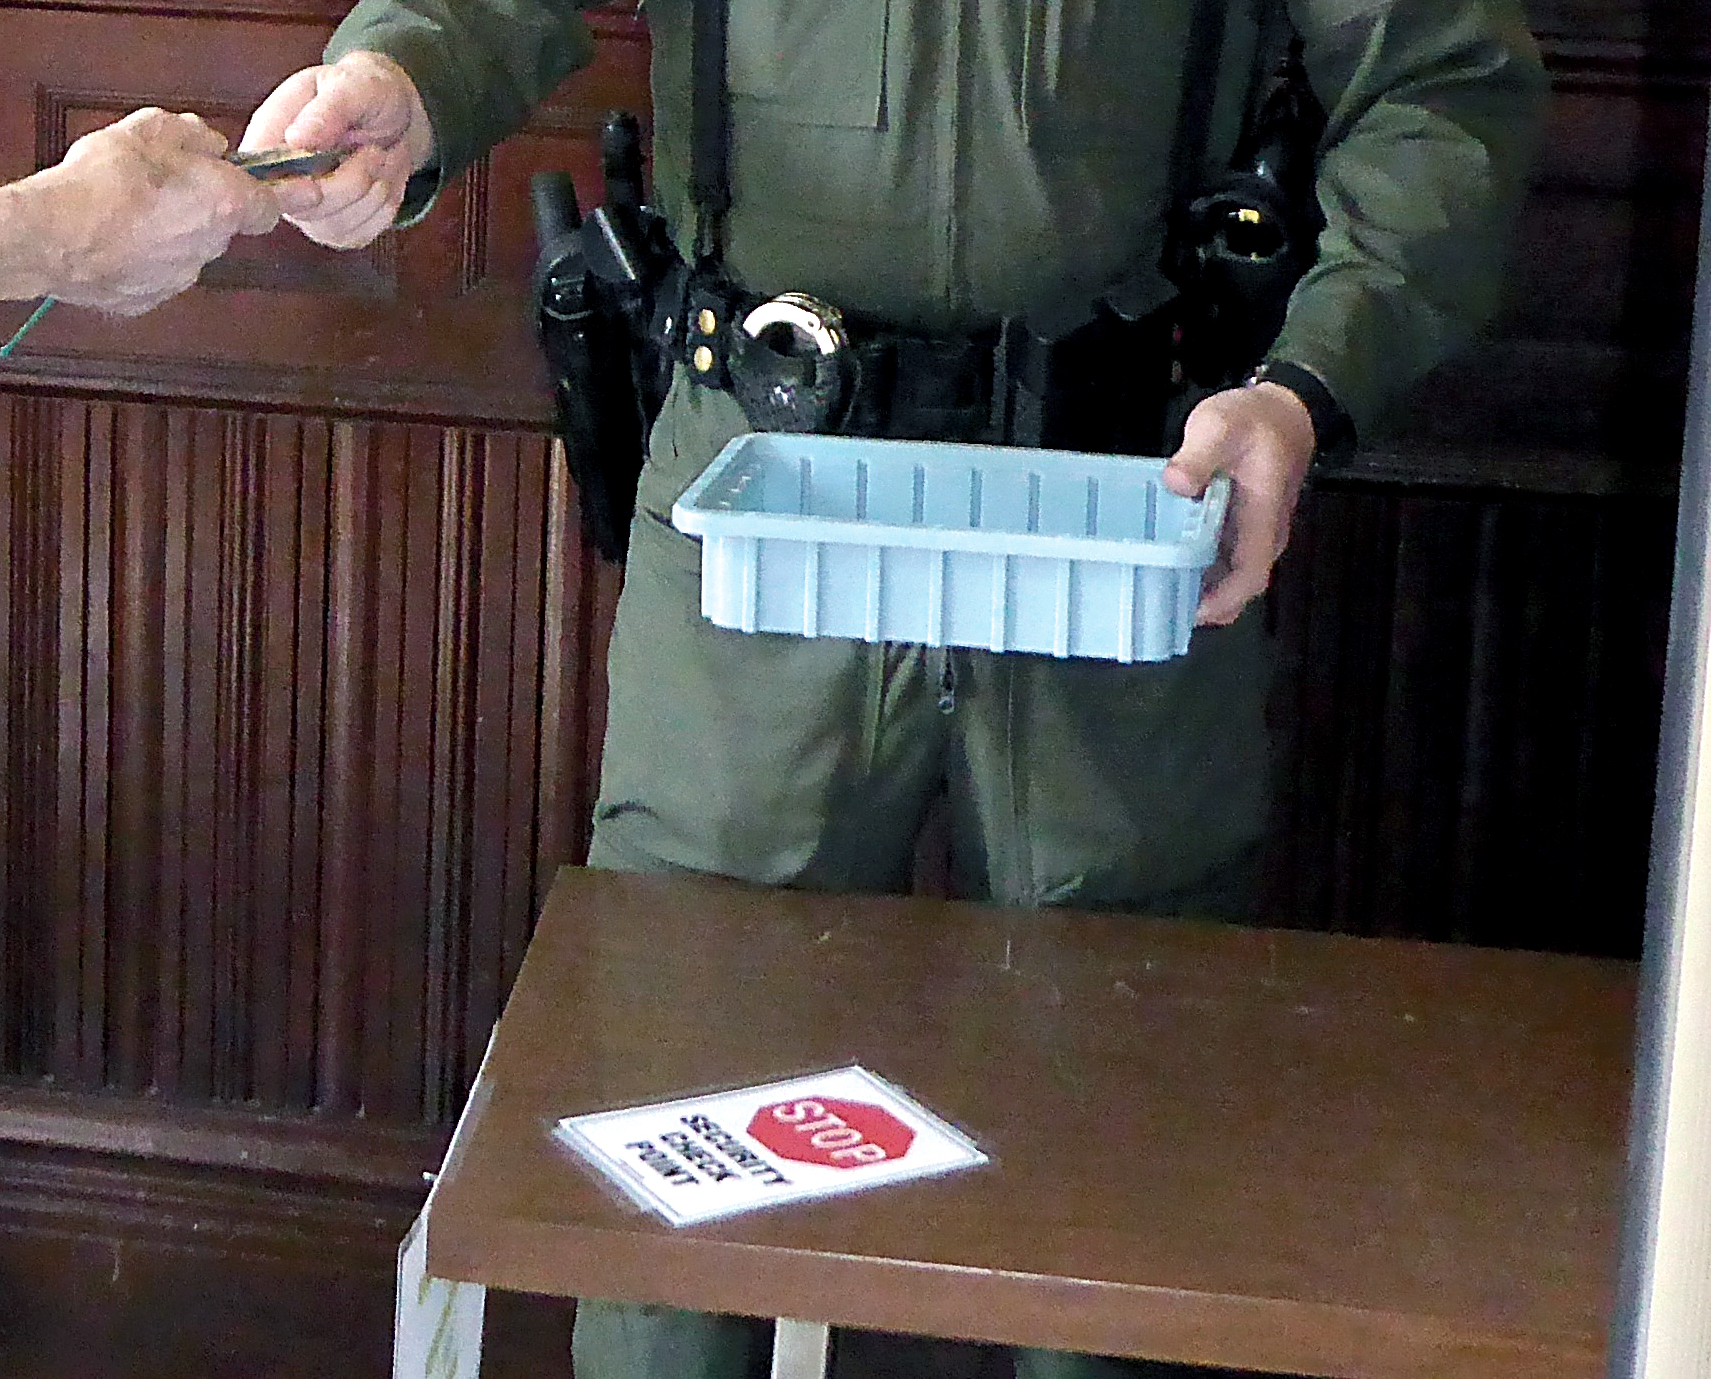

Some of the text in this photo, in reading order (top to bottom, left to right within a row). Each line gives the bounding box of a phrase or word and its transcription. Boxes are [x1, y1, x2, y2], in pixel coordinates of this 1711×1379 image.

[659, 1131, 741, 1182] CHECK
[680, 1113, 794, 1186] SECURITY
[772, 1100, 887, 1163] STOP
[625, 1140, 700, 1185] POINT
